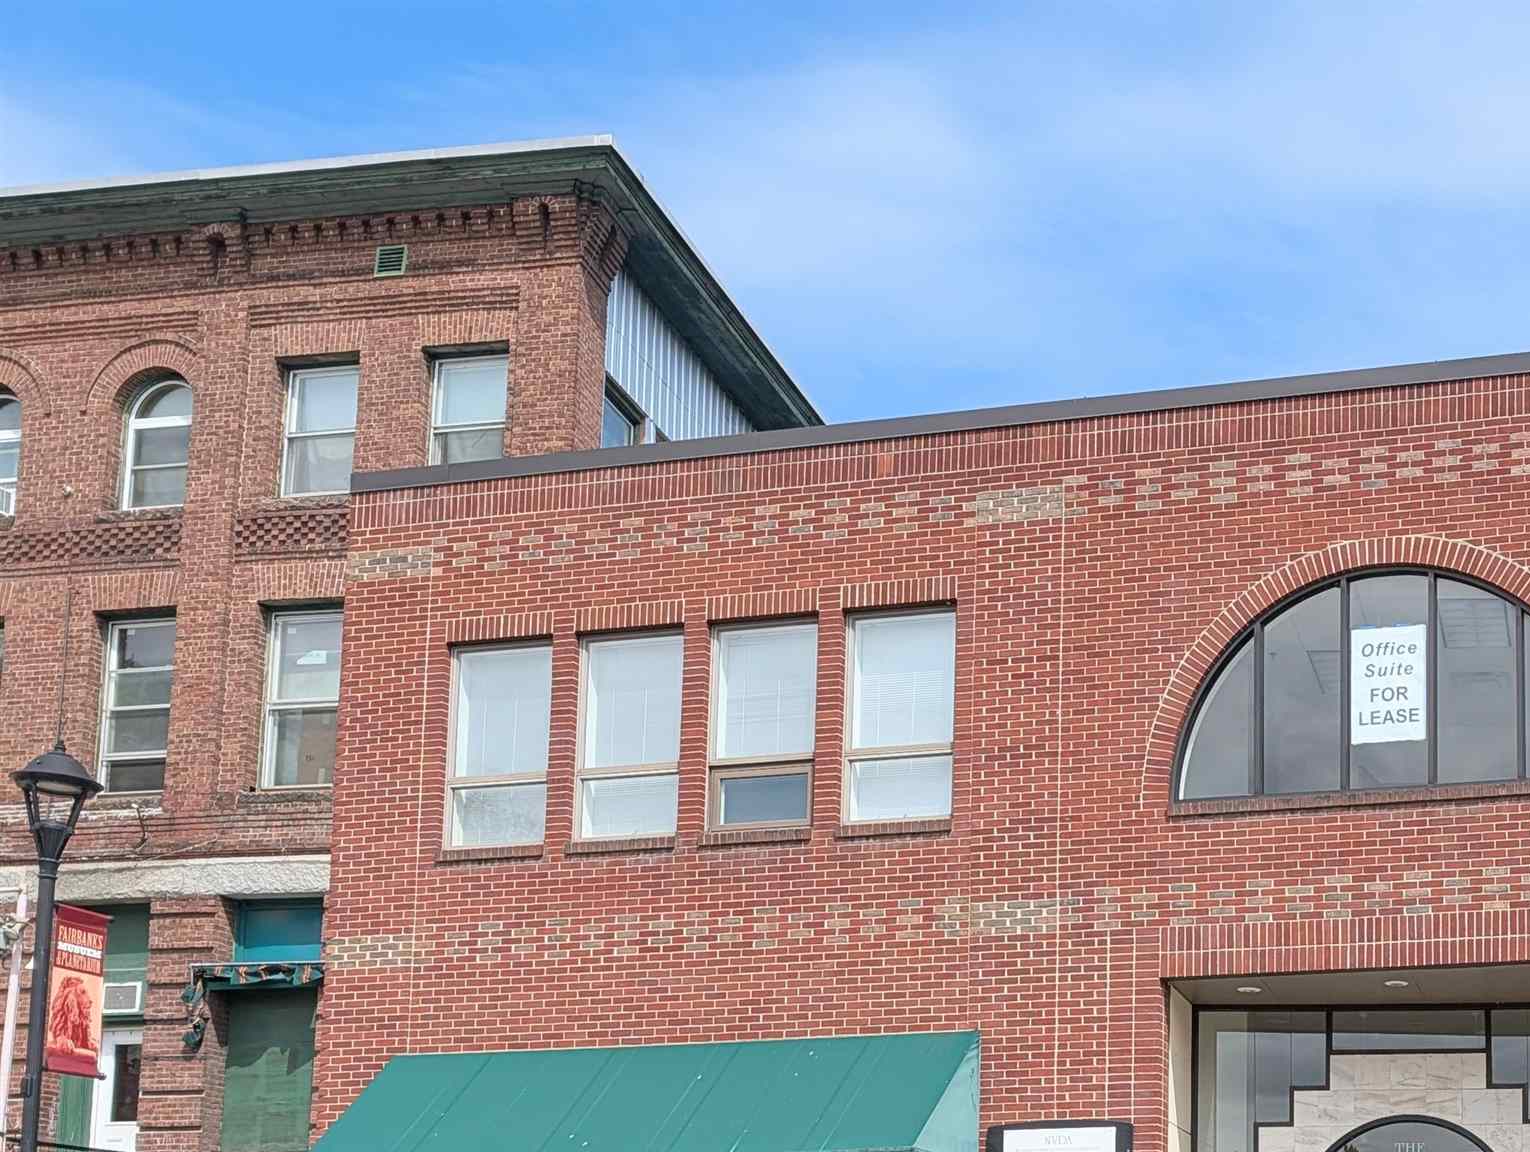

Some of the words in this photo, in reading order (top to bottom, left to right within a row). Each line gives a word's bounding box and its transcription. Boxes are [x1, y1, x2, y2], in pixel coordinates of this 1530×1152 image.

[1361, 641, 1417, 658] Office
[1364, 662, 1414, 678] Suite
[1370, 686, 1409, 703] FOR
[1358, 707, 1421, 726] LEASE
[58, 925, 104, 950] FAIRBANKS
